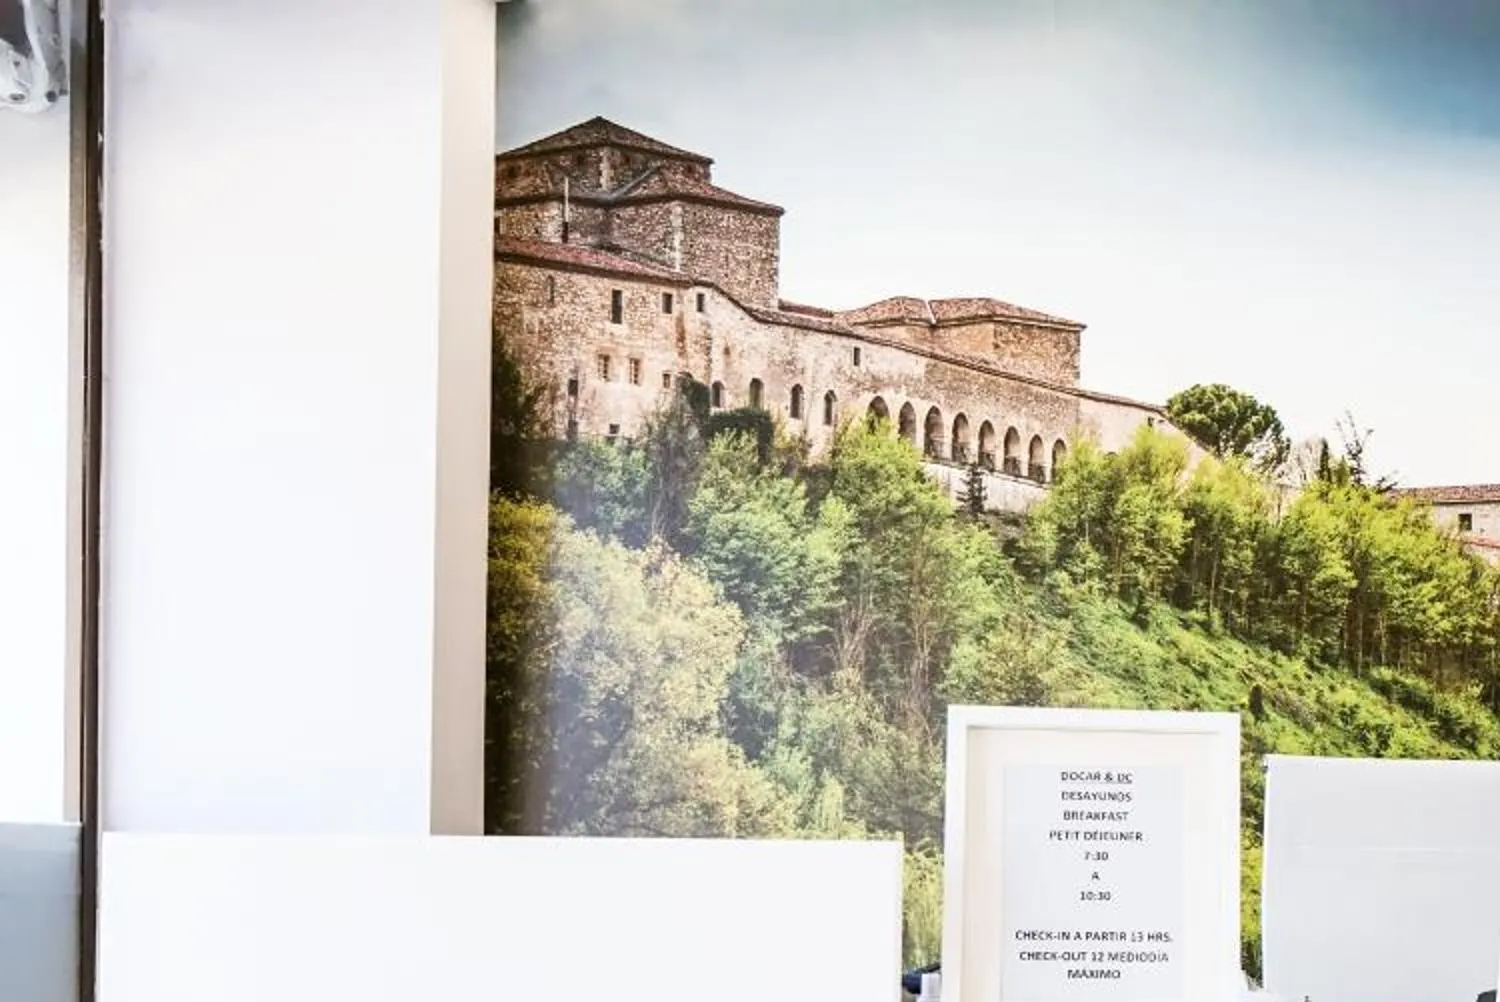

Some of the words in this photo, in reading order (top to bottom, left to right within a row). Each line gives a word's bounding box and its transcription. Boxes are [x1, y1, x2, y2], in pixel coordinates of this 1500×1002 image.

[1060, 771, 1102, 782] DOCAR
[1104, 772, 1113, 783] &
[1117, 773, 1133, 784] DC
[1061, 791, 1132, 803] DESAYUNOS
[1063, 810, 1129, 821] BREAKFAST
[1049, 830, 1079, 841] PETIT
[1084, 851, 1109, 862] 7:30
[1091, 871, 1100, 881] A
[1080, 891, 1111, 901] 10:30
[1015, 930, 1071, 941] CHECK-IN
[1074, 931, 1083, 941] A
[1085, 931, 1127, 942] PARTIR
[1019, 951, 1087, 962] CHECK-OUT
[1091, 951, 1104, 962] 12
